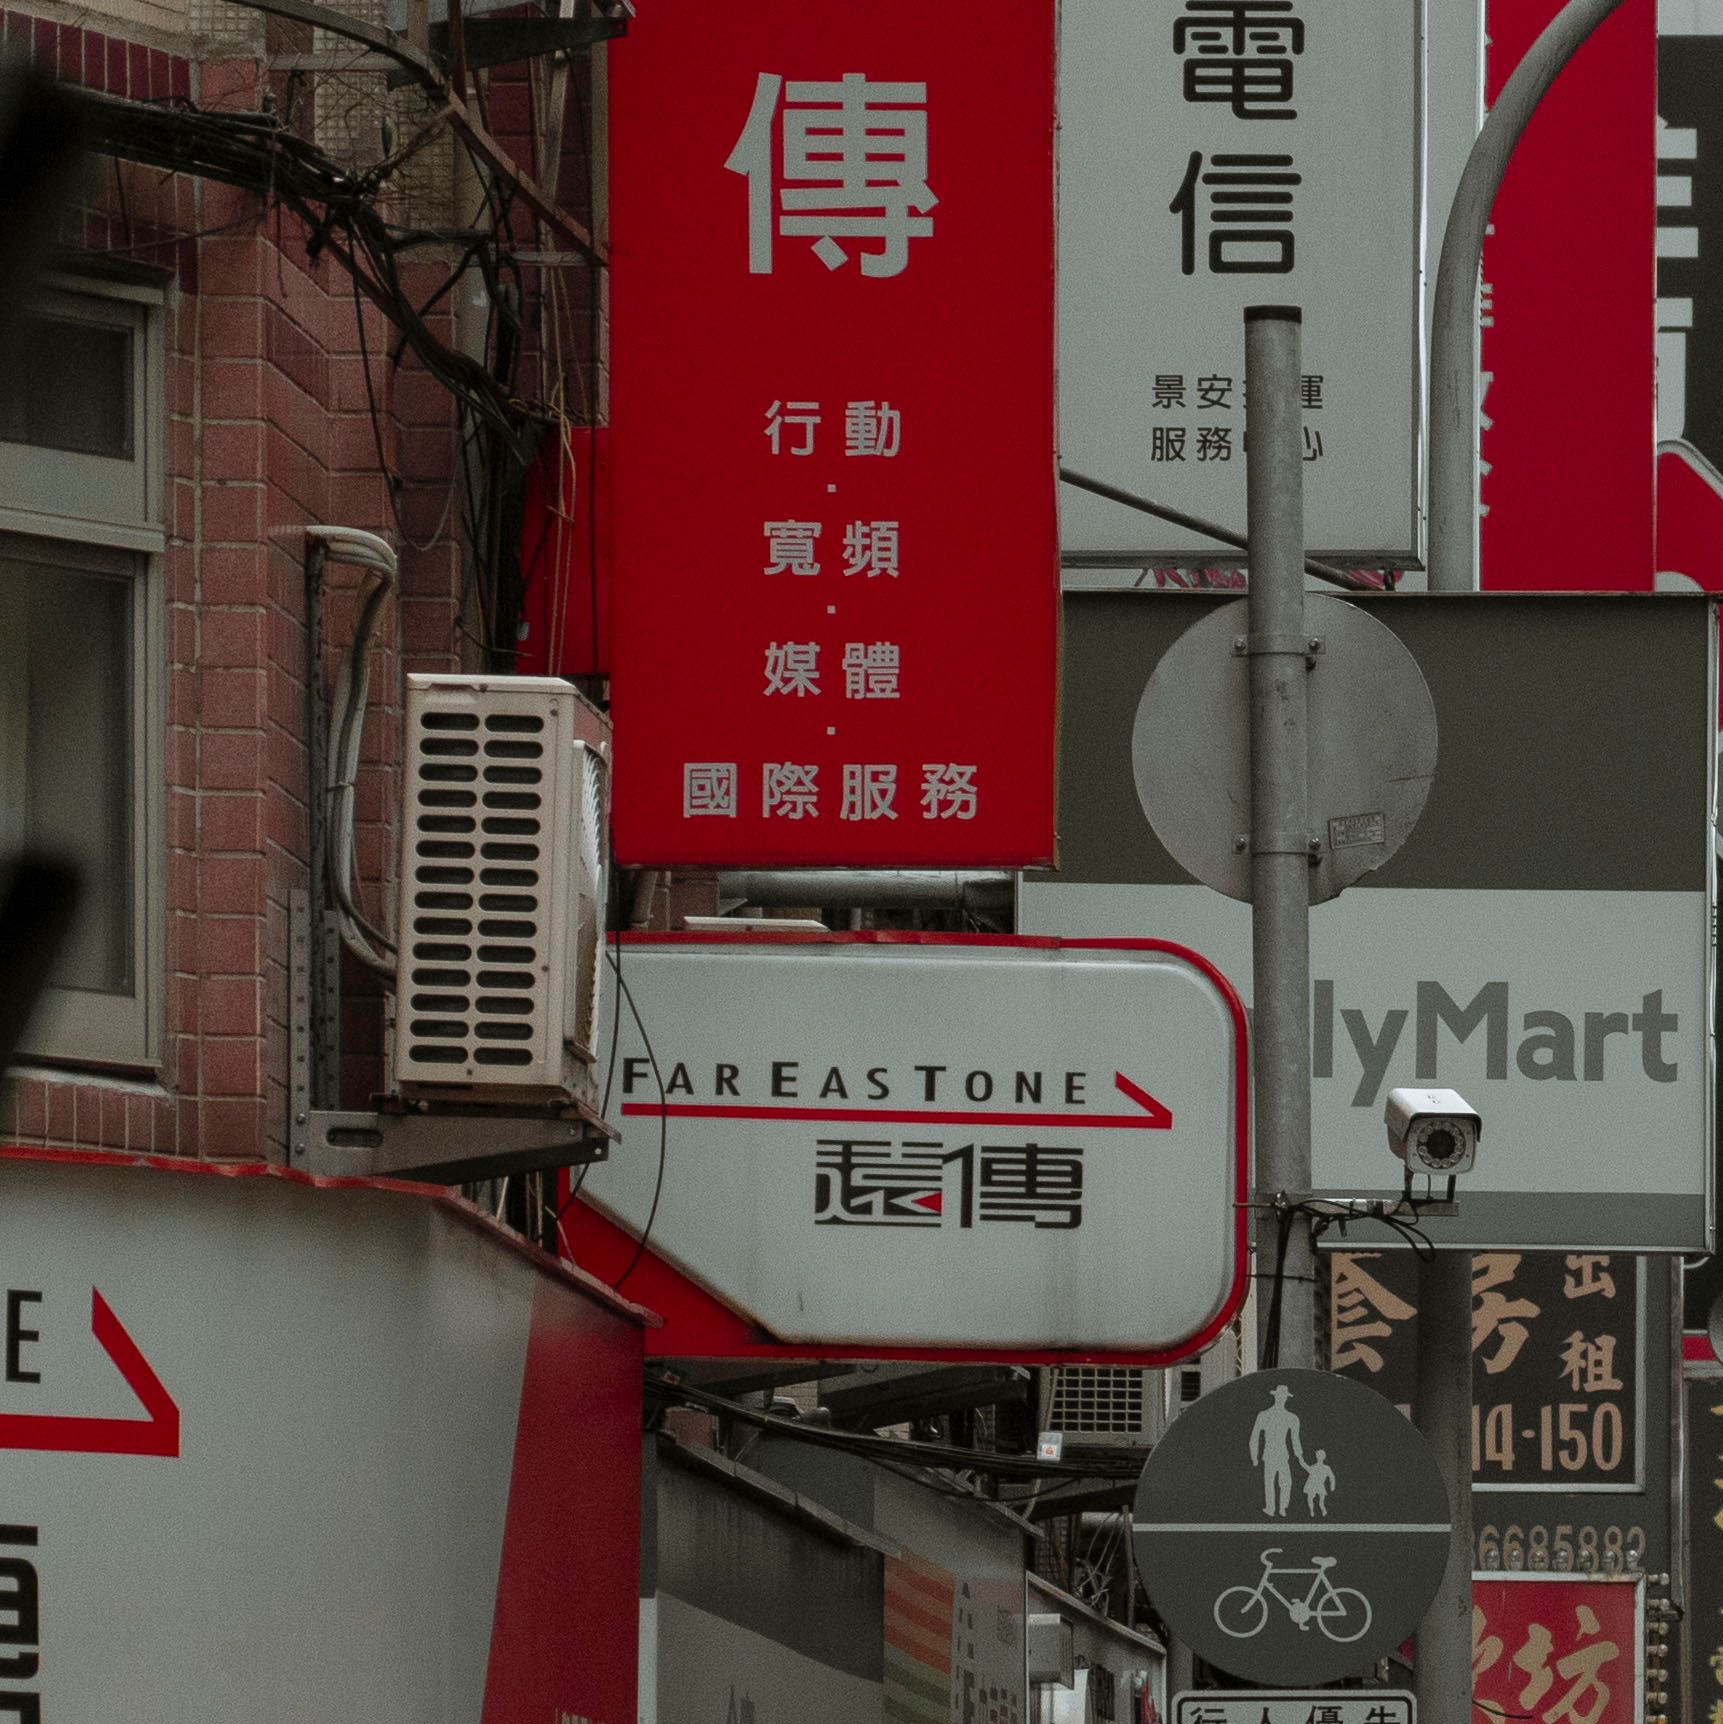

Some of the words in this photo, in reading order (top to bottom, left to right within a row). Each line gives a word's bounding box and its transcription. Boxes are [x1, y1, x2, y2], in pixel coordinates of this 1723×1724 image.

[1169, 0, 1306, 275] 電信
[723, 72, 939, 278] 傳
[1151, 374, 1324, 410] 景安運
[763, 400, 900, 457] 行動
[1151, 426, 1324, 462] 服務心
[763, 520, 899, 577] 寬頻
[763, 641, 900, 699] 媒體
[683, 762, 978, 820] 國際服務
[1313, 979, 1679, 1107] lyMart
[622, 1057, 1087, 1104] FAREASTONE
[814, 1140, 1083, 1229] 遠傳
[1559, 1255, 1624, 1393] 出租
[1472, 1524, 1646, 1572] 6685882
